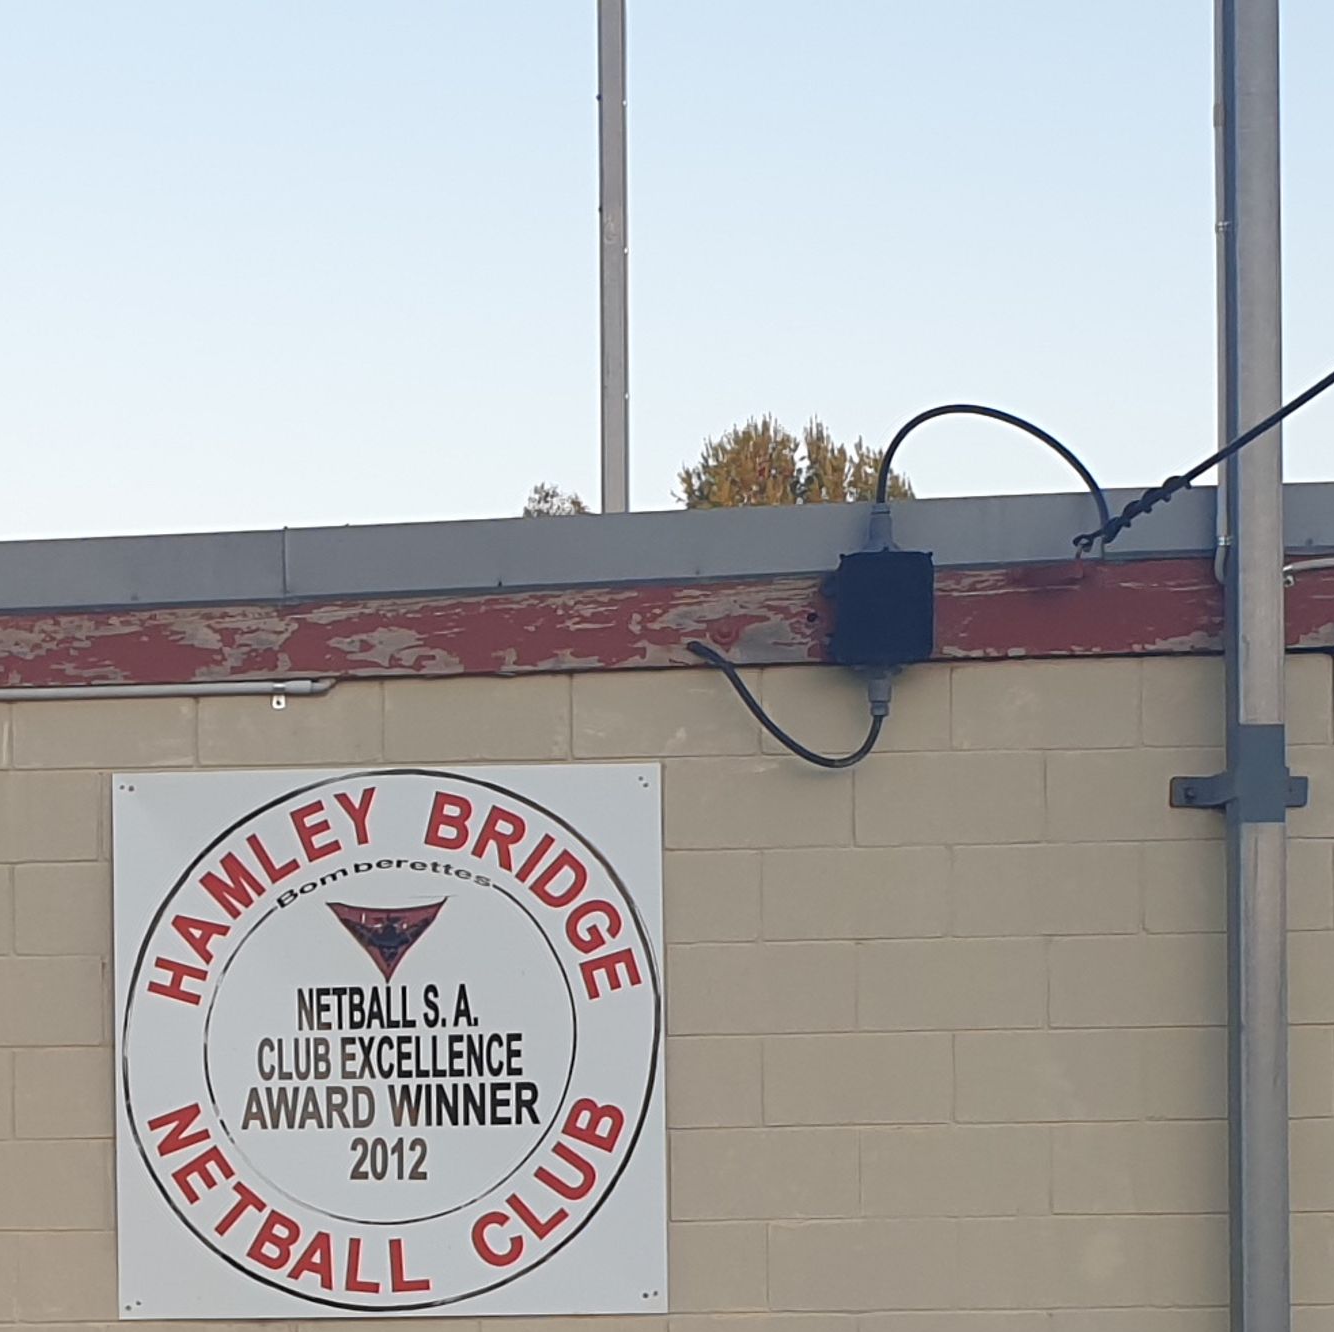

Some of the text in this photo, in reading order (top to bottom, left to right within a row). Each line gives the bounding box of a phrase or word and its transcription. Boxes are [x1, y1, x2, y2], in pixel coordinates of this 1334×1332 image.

[147, 785, 643, 1006] HAMLEY BRIDGE
[276, 858, 492, 909] Bomberettes
[297, 983, 479, 1031] NETBALL S. A.
[257, 1032, 524, 1081] CLUB EXCELLENCE
[241, 1081, 541, 1130] AWARD WINNER
[349, 1137, 428, 1181] 2012
[147, 1097, 626, 1295] NETBALL CLUB
